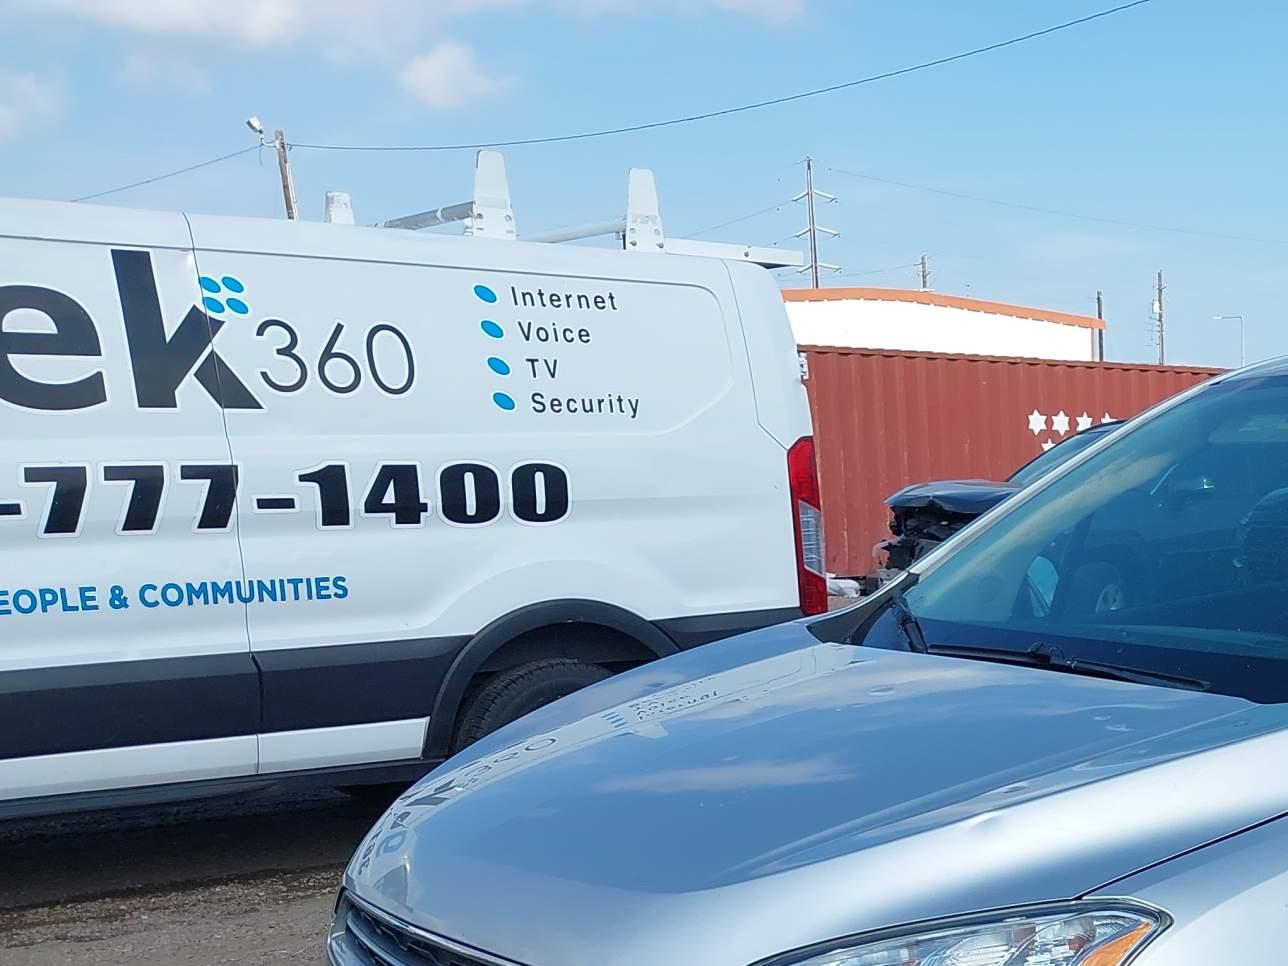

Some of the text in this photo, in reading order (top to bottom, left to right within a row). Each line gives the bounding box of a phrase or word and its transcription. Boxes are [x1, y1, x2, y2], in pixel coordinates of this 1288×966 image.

[511, 286, 618, 311] Internet
[518, 320, 592, 343] Voice
[525, 358, 558, 379] TV
[531, 392, 640, 419] Security
[109, 585, 129, 610] &
[139, 576, 349, 608] COMMUNITIES
